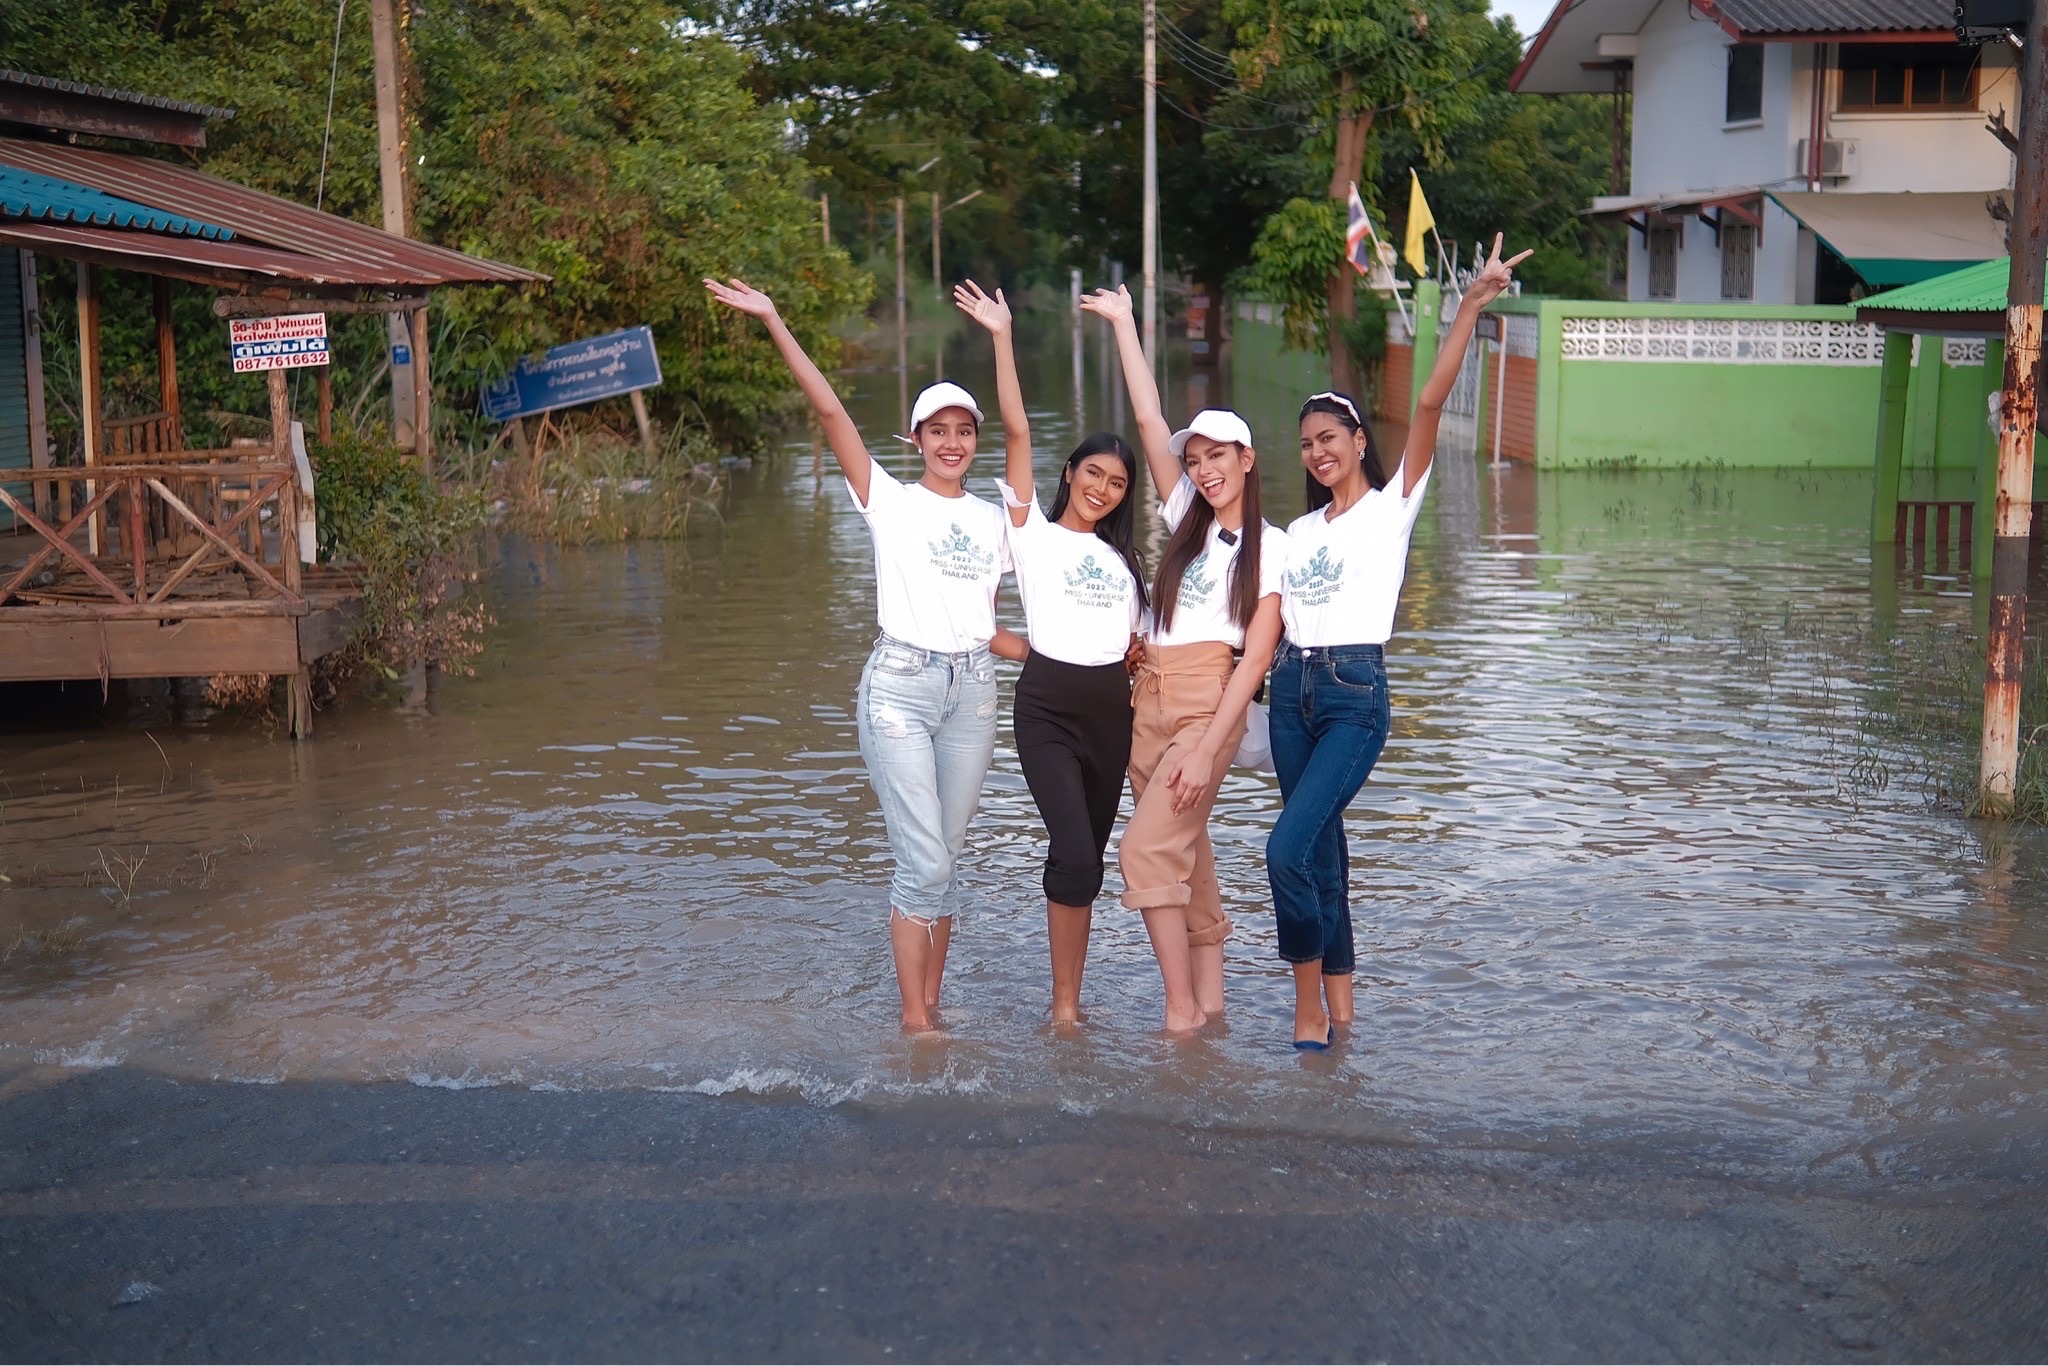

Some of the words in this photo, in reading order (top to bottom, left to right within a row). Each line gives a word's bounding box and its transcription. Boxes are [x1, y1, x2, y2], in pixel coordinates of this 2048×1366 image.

[236, 353, 326, 370] 087-7616632
[951, 554, 972, 563] 2022
[930, 558, 948, 568] MISS
[954, 563, 992, 575] UNIVERSE
[941, 569, 979, 580] THAILAND
[1086, 583, 1106, 591] 2022
[1181, 583, 1193, 592] 022
[1309, 579, 1324, 589] 2022
[1064, 589, 1083, 598] MISS
[1089, 592, 1126, 602] UNIVERSE
[1311, 583, 1341, 597] UNIVERSE
[1077, 599, 1112, 609] THAILAND
[1301, 595, 1331, 606] THAILAND
